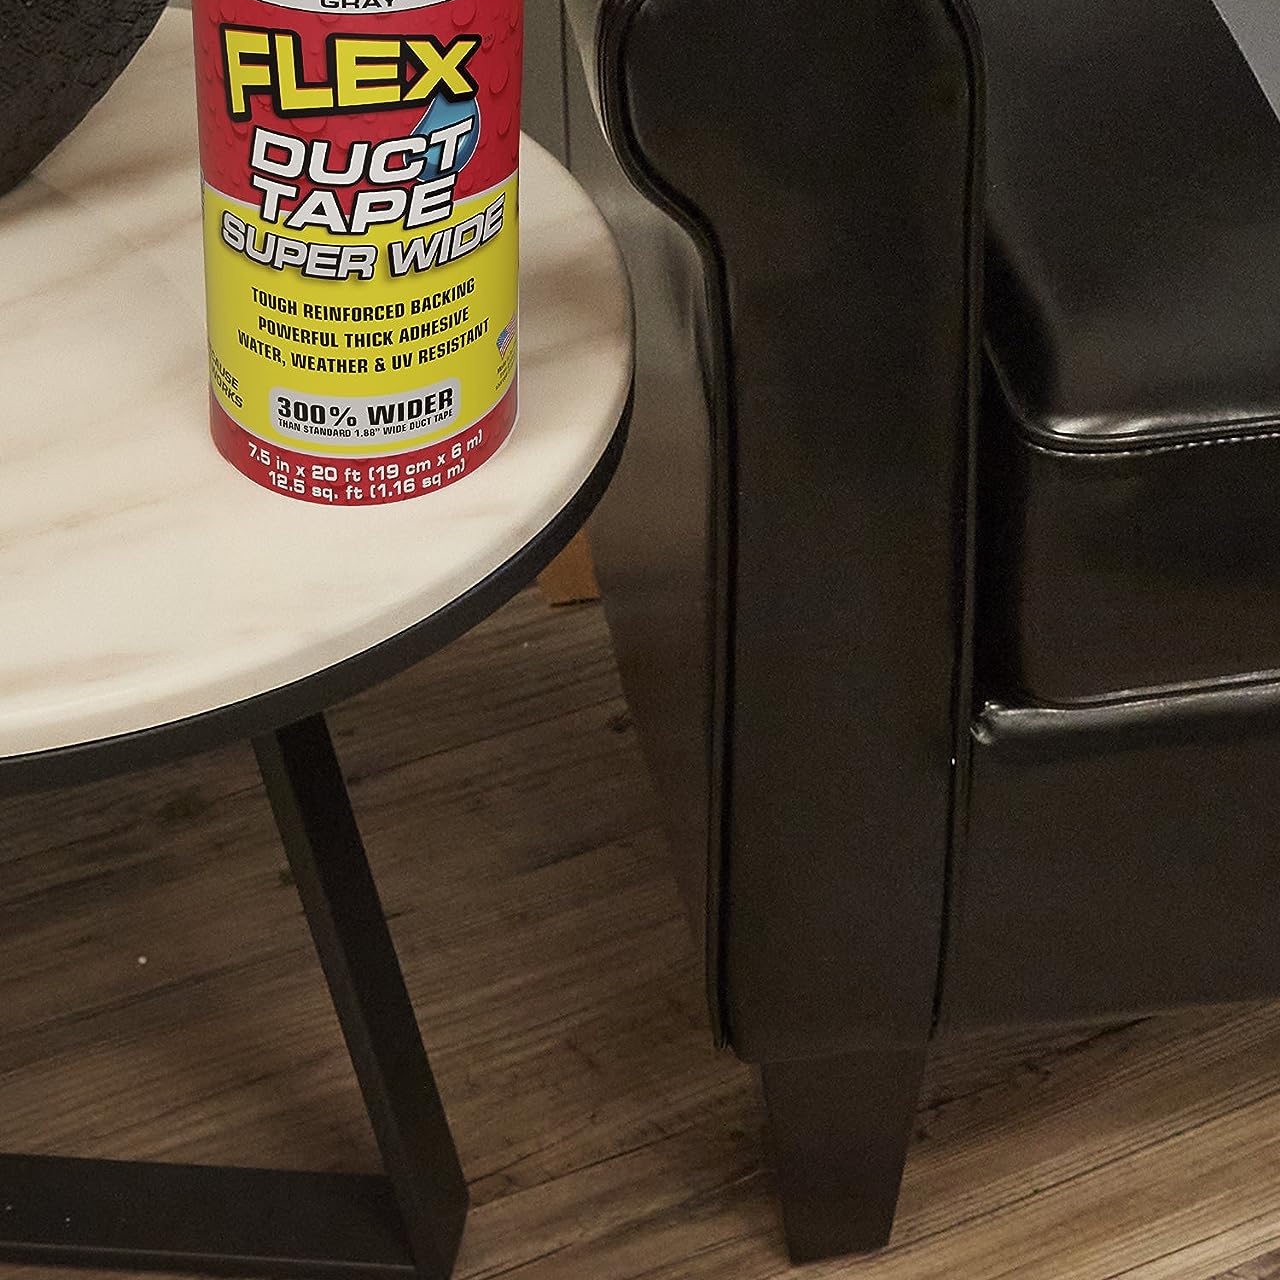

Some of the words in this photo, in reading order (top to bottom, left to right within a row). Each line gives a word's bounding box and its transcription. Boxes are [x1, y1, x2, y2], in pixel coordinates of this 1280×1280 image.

[221, 24, 482, 122] FLEX
[251, 118, 474, 186] DUCT
[252, 173, 457, 233] TAPE
[222, 211, 378, 280] SUPER
[389, 192, 506, 278] WIDE
[251, 286, 297, 316] TOUGH
[303, 302, 405, 322] REINFORCED
[411, 277, 475, 316] BACKING
[237, 328, 286, 367] WATER,
[290, 352, 368, 373] WEATHER
[374, 357, 386, 372] &
[392, 352, 413, 370] UV
[418, 317, 490, 365] RESISTANT
[258, 315, 339, 348] POWERFUL
[344, 330, 394, 348] THICK
[399, 306, 470, 344] ADHESIVE
[277, 396, 357, 427] 300%
[367, 387, 453, 426] WIDER
[278, 417, 301, 432] THAN
[303, 425, 351, 438] STANDARD
[383, 424, 407, 436] WIDE
[409, 418, 432, 431] DUCT
[434, 408, 453, 423] TAPE
[248, 441, 271, 466] 7.5
[276, 456, 290, 473] in
[295, 465, 306, 477] x
[311, 464, 338, 482] 20
[344, 468, 361, 482] ft
[368, 463, 399, 482] (19
[405, 459, 431, 476] cm
[436, 453, 446, 467] x
[451, 442, 462, 460] 6
[466, 428, 483, 452] m)
[268, 470, 305, 494] 12.5
[311, 486, 339, 503] sq.
[345, 485, 363, 500] ft
[370, 477, 416, 499] (1.16
[421, 472, 442, 489] sq
[447, 458, 465, 480] m)
